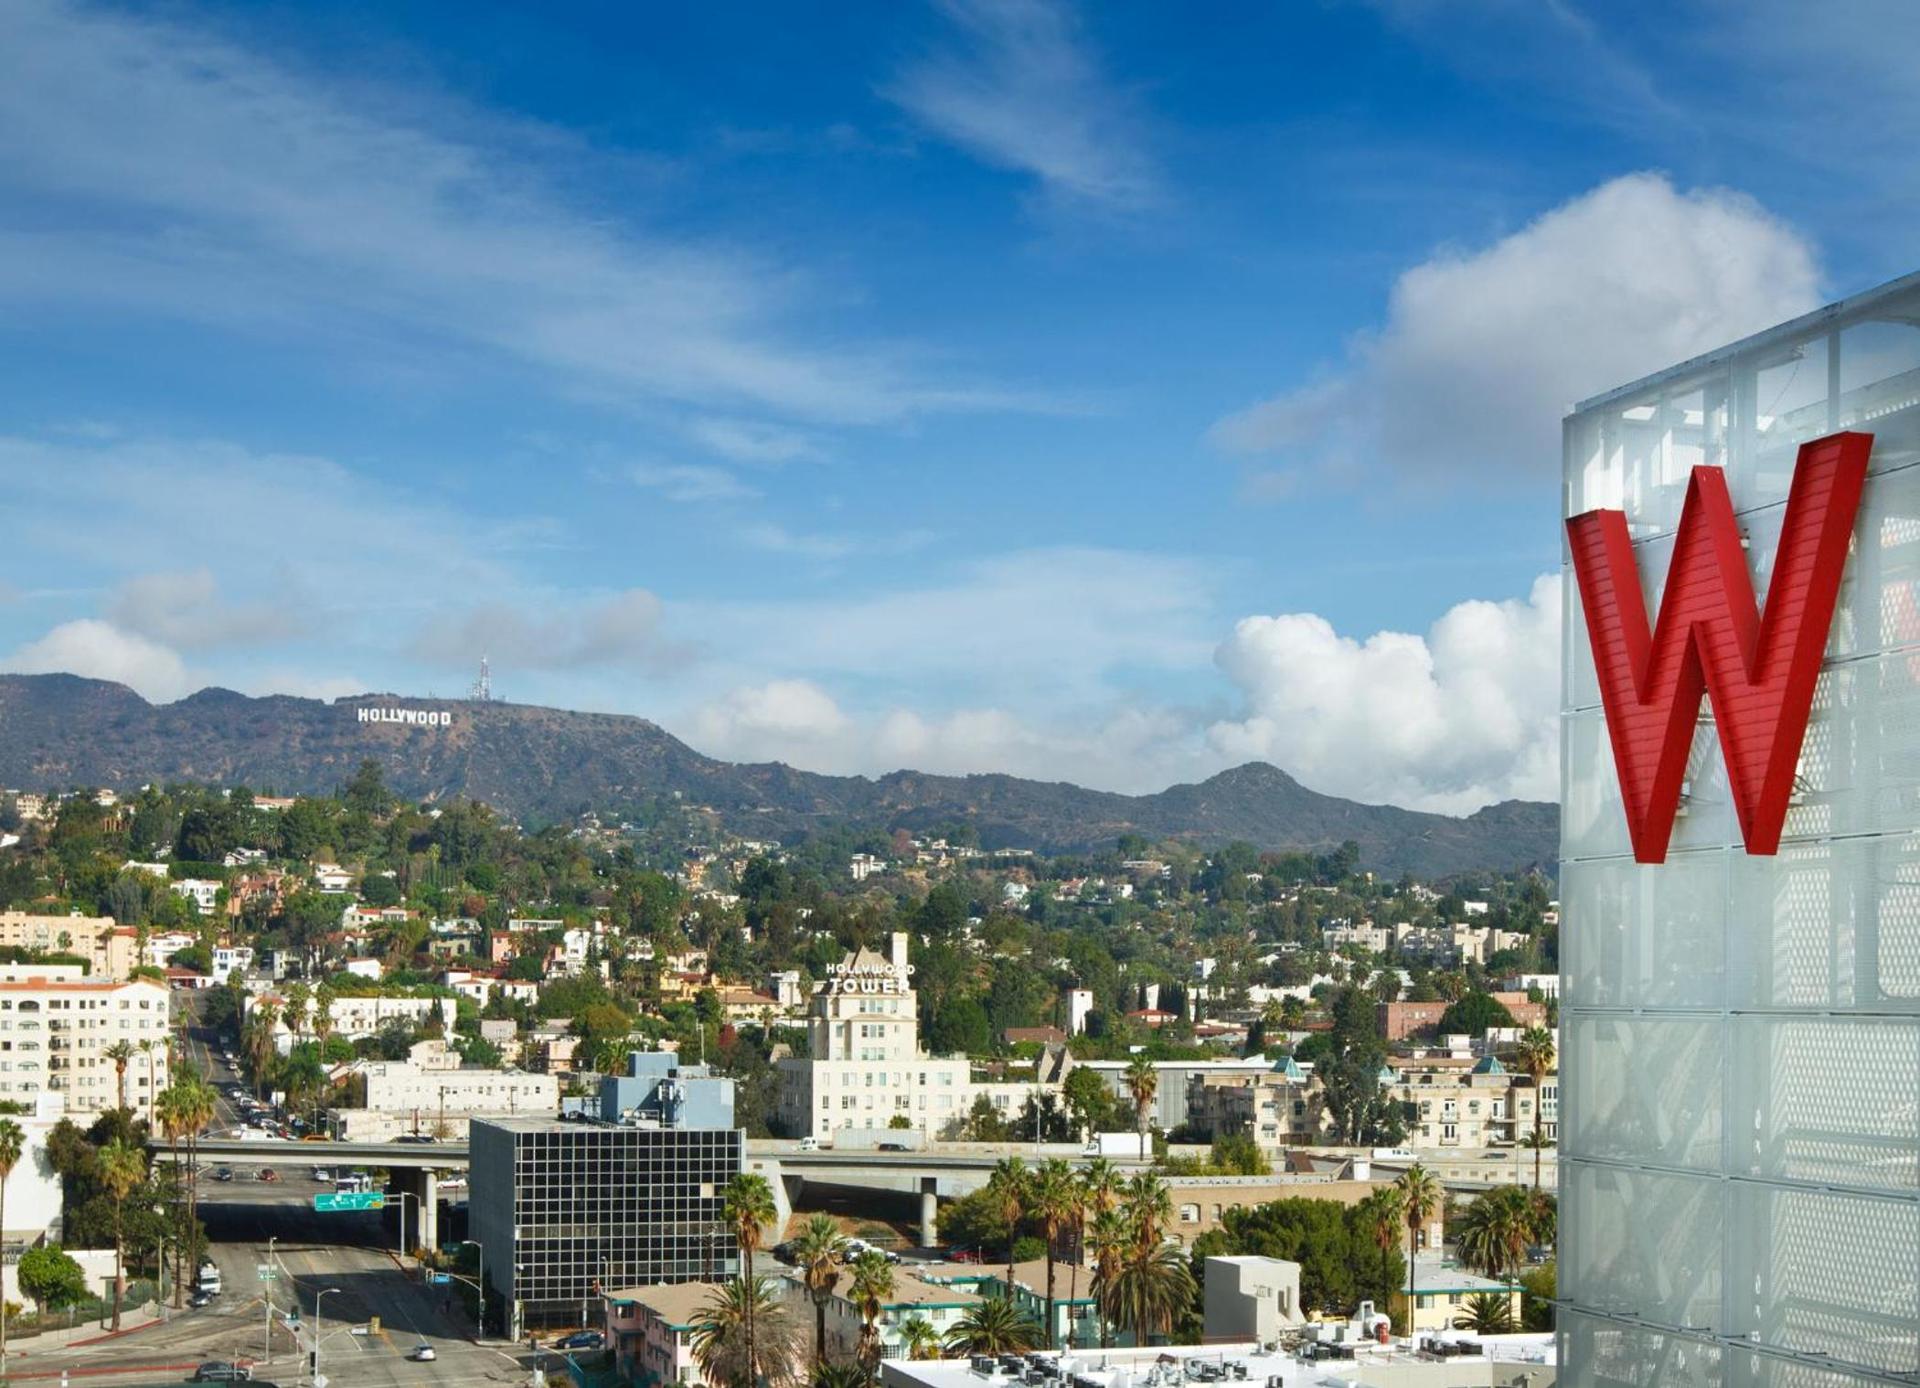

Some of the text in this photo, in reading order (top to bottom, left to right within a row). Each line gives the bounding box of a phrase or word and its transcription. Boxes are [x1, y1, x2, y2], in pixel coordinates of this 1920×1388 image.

[1566, 431, 1874, 864] W
[358, 708, 451, 725] HOLLYWOOD
[830, 978, 910, 993] TOWER
